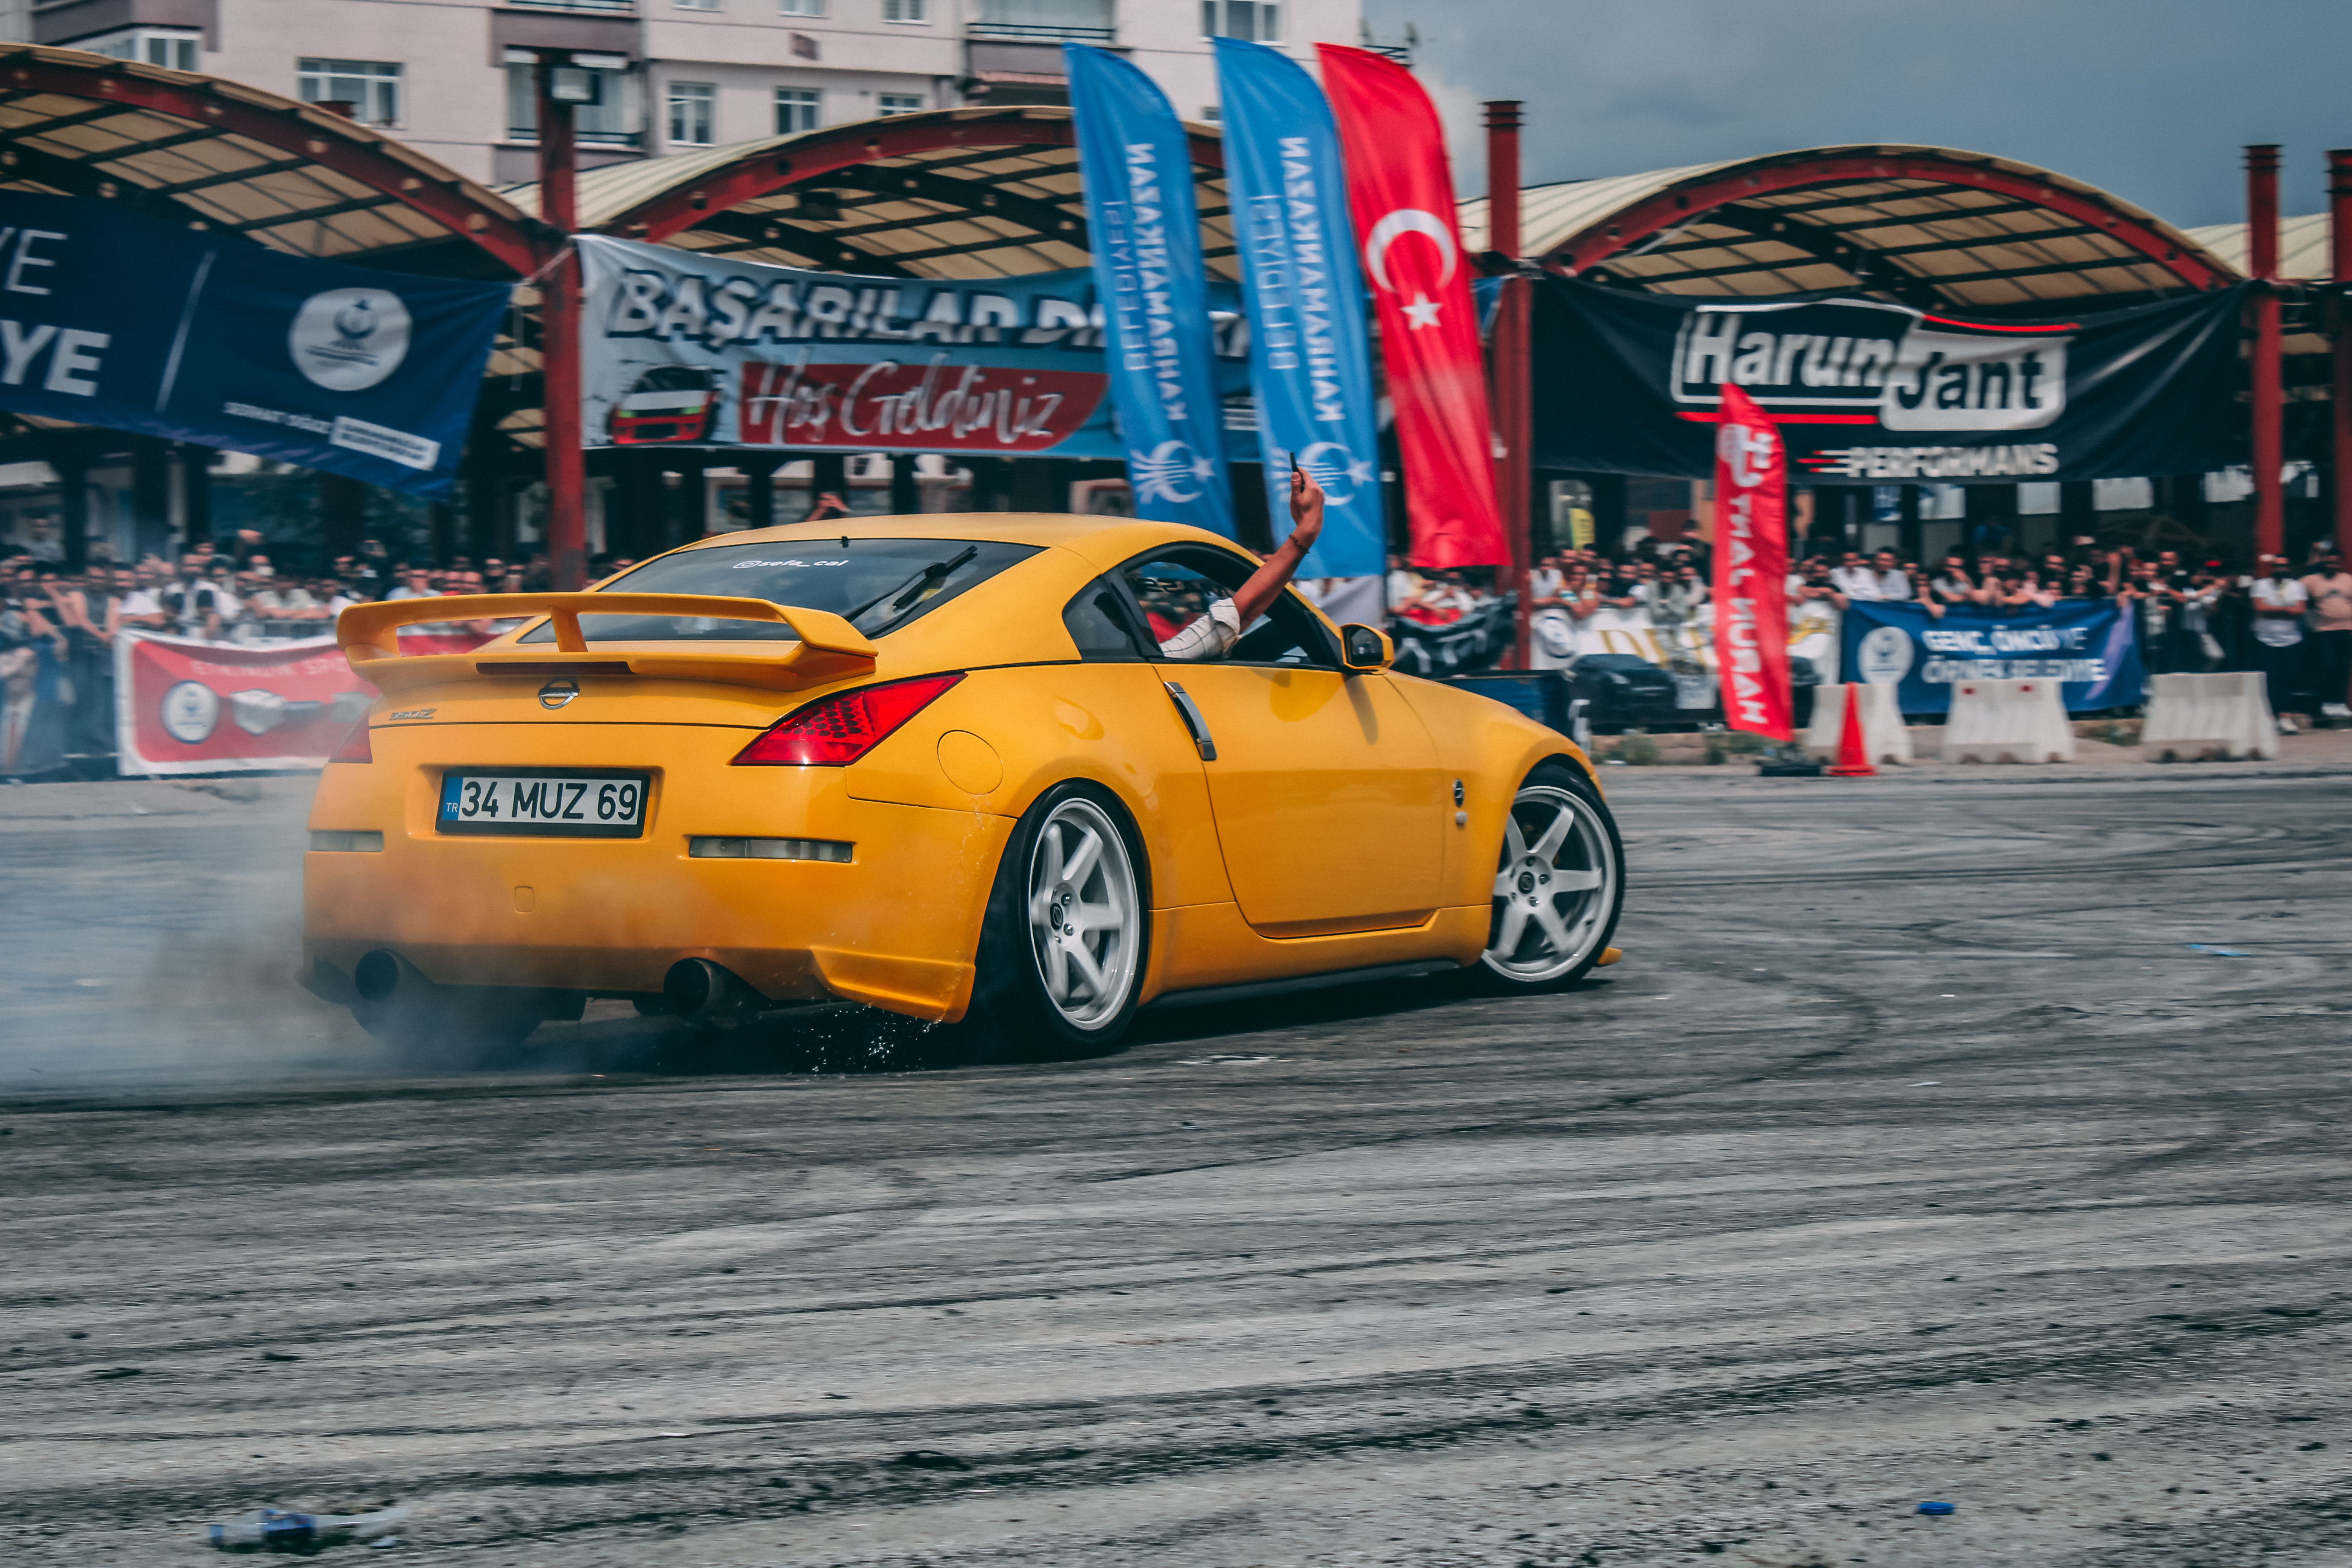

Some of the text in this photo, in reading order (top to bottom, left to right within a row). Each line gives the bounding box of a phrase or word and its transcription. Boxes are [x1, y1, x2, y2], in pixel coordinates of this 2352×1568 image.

[0, 227, 68, 296] E
[1684, 314, 2045, 410] Harun Jant
[446, 781, 638, 820] TR 34 MUZ 69
